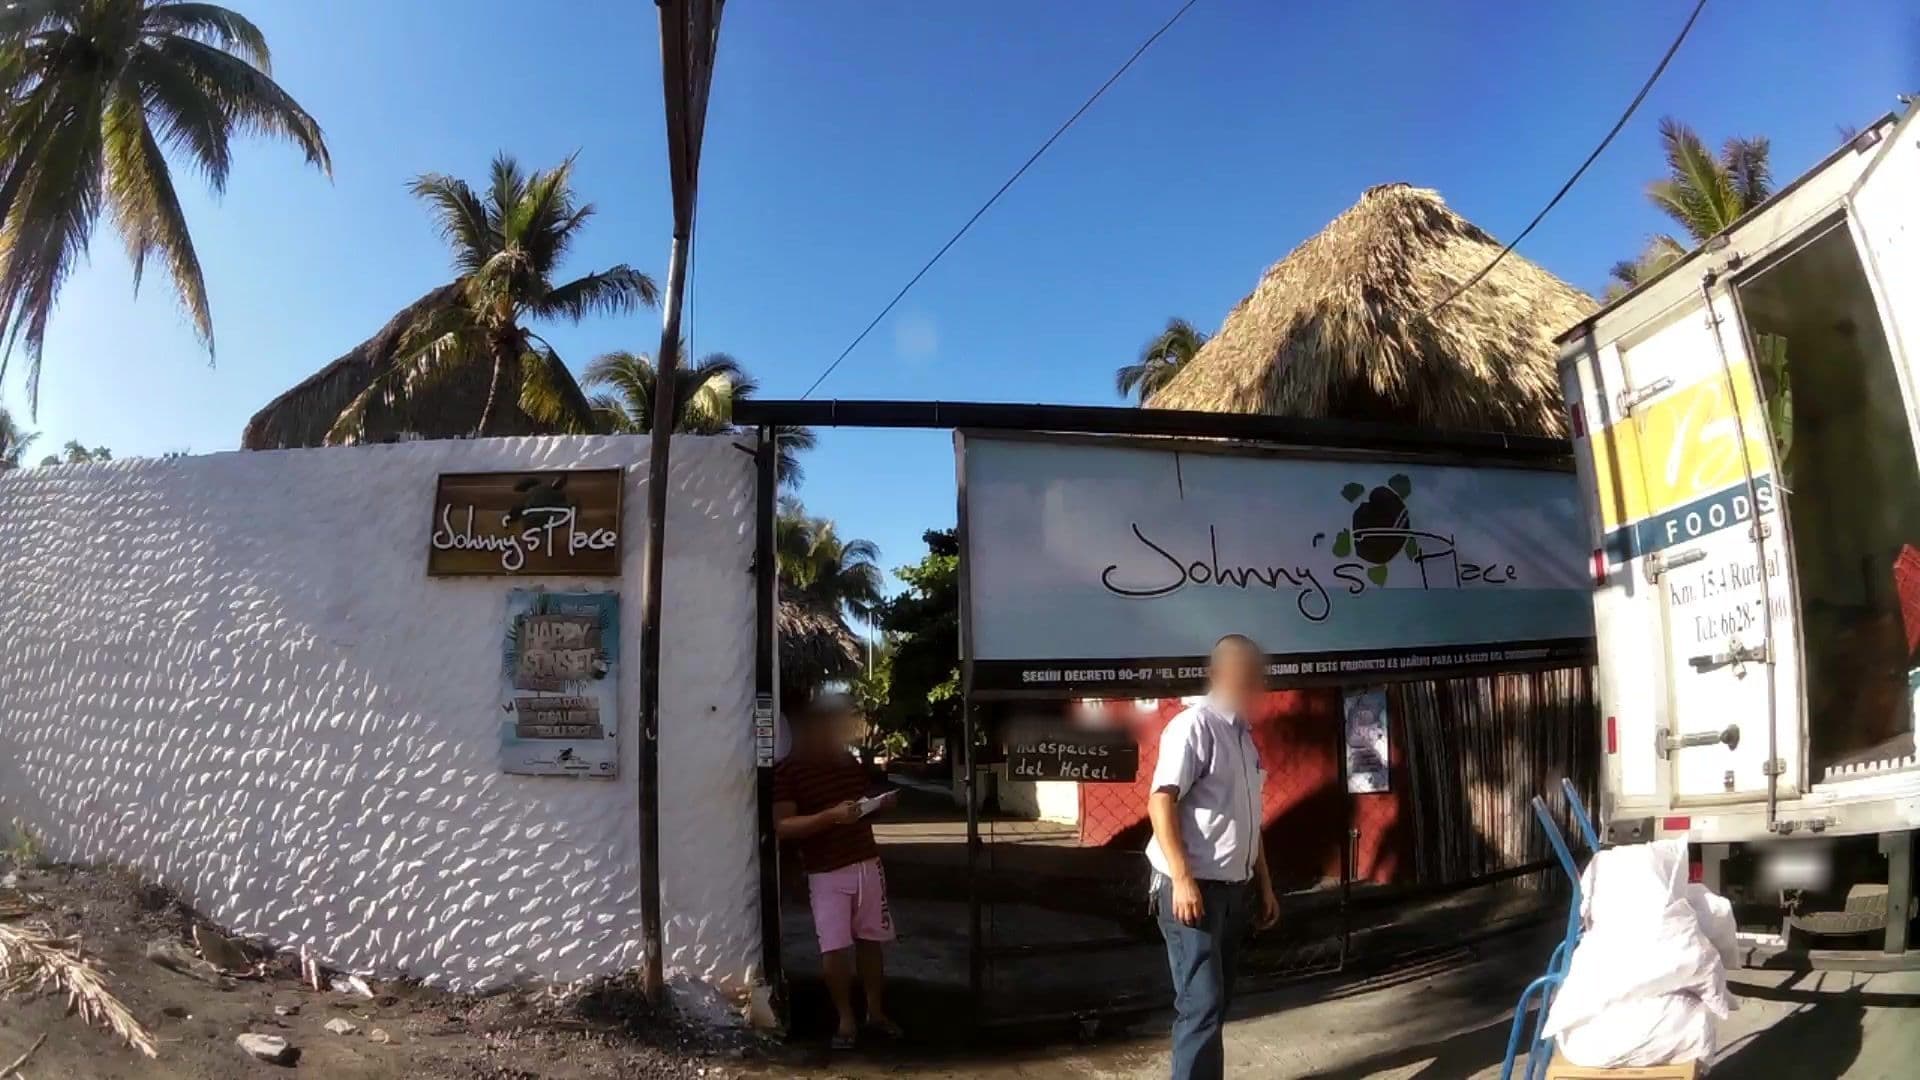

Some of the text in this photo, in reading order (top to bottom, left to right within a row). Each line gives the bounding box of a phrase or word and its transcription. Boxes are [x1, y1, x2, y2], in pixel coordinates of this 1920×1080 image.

[432, 503, 618, 571] Johnny's Place
[1665, 486, 1774, 543] FOODS
[1101, 523, 1519, 622] Johnny's Place
[1064, 668, 1115, 682] DECRETO
[1014, 757, 1109, 780] del Hotel
